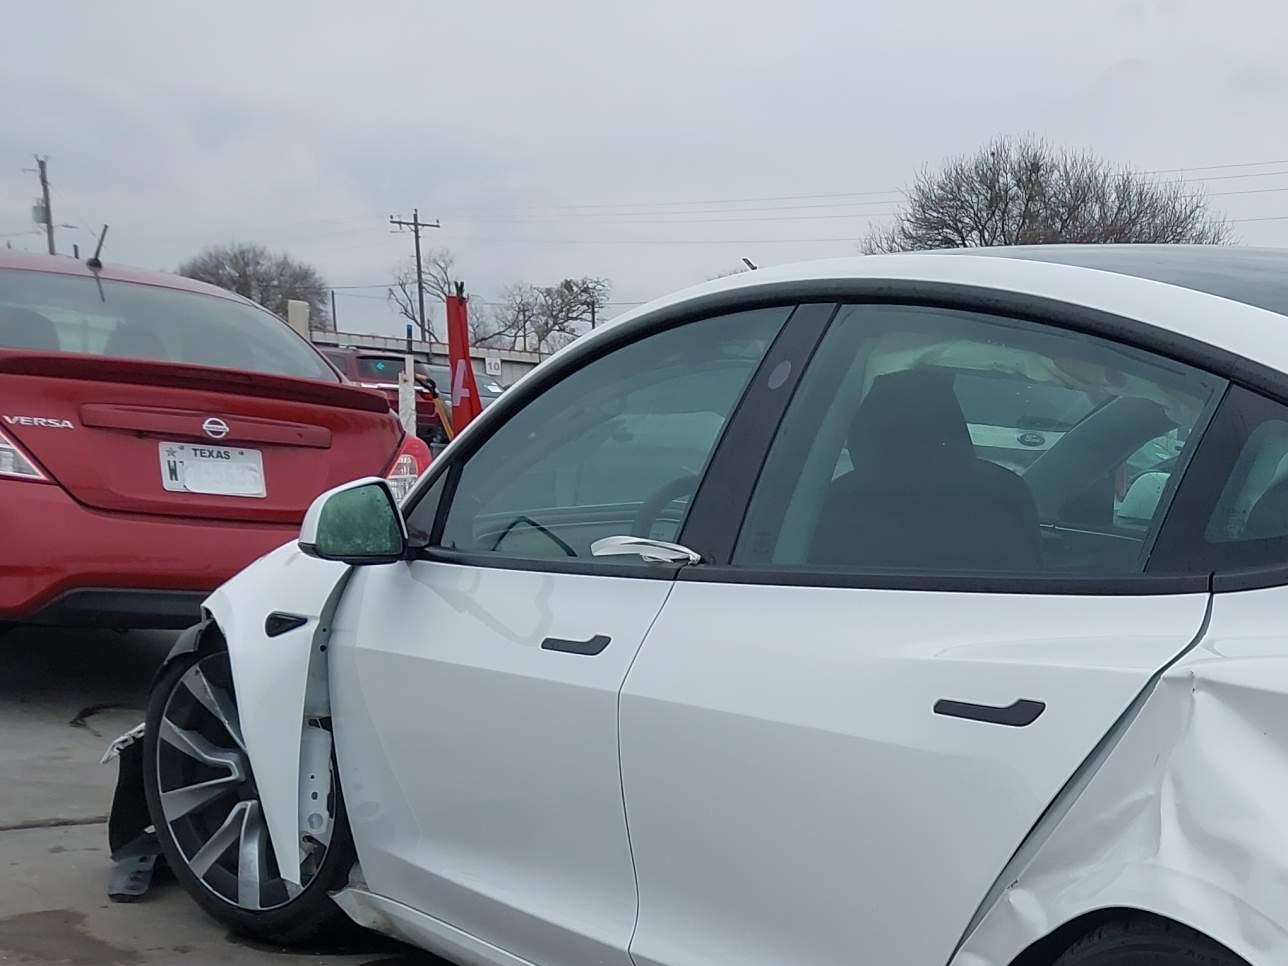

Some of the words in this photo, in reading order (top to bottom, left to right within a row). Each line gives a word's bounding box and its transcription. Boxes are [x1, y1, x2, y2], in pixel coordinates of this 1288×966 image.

[487, 361, 500, 371] 10
[2, 415, 75, 430] VERSA
[192, 448, 231, 460] TEXAS
